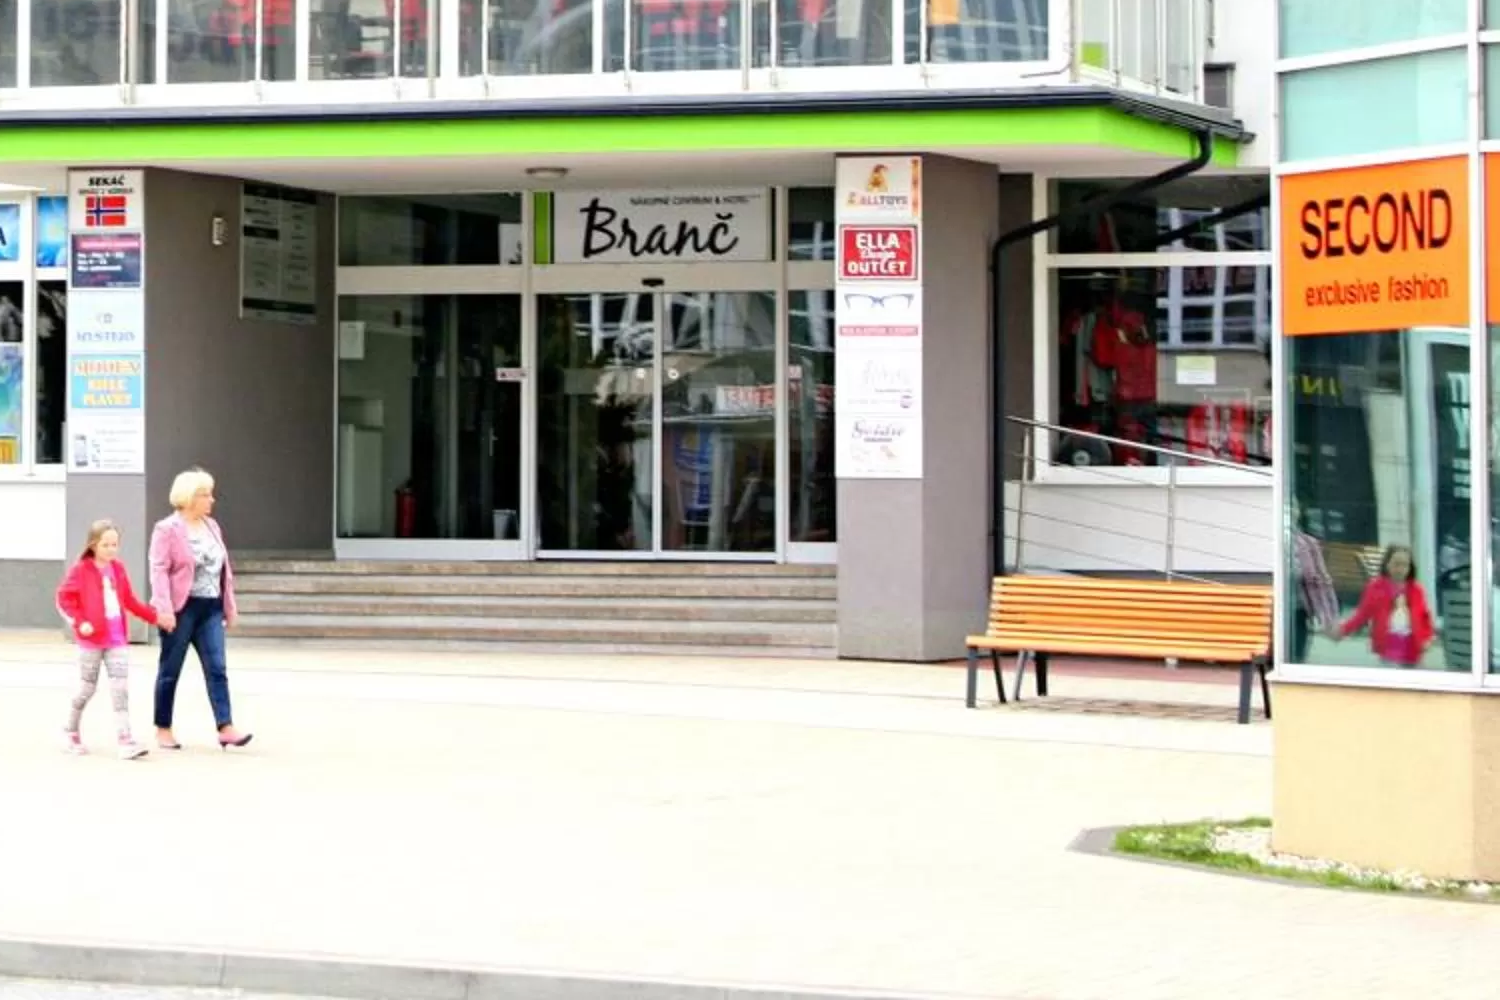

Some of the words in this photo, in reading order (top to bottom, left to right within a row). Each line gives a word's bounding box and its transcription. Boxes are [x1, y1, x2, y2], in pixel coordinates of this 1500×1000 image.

[580, 198, 739, 258] Branč
[856, 232, 900, 248] ELLA
[1301, 189, 1452, 259] SECOND
[848, 261, 906, 274] OUTLET
[1306, 277, 1380, 307] exclusive
[1388, 273, 1448, 302] fashion
